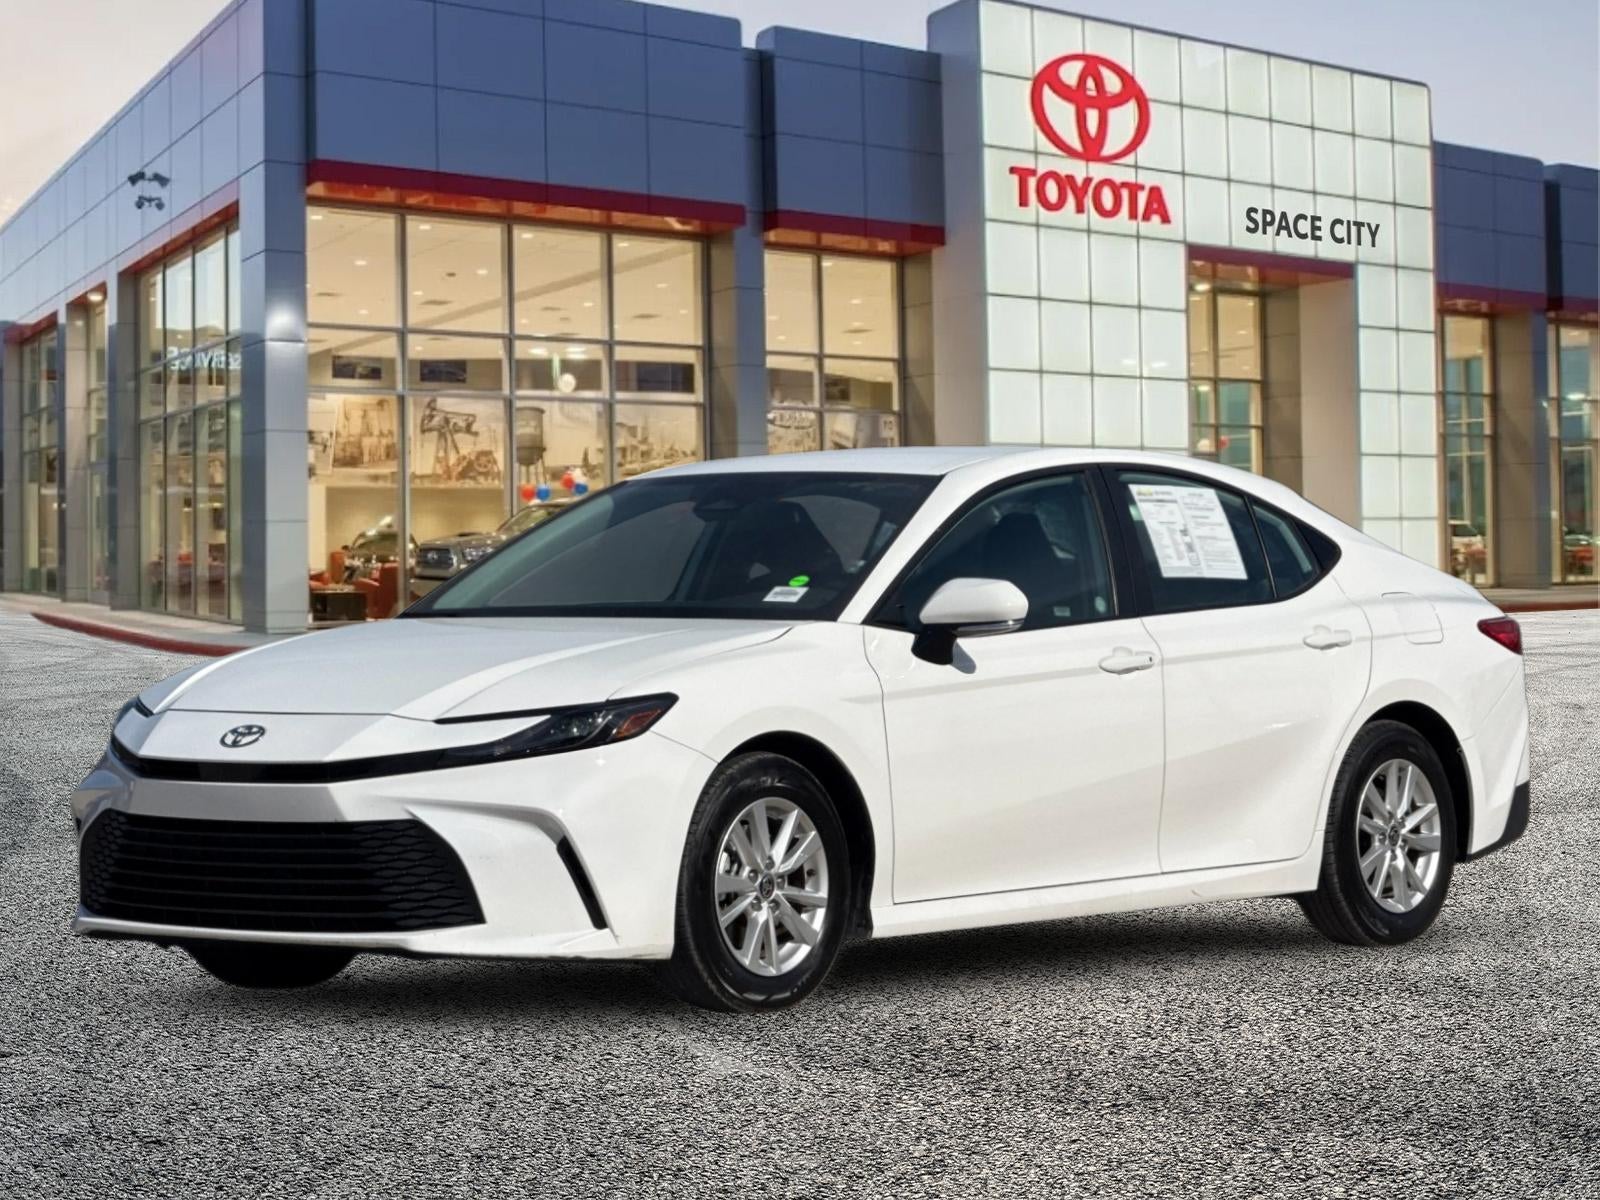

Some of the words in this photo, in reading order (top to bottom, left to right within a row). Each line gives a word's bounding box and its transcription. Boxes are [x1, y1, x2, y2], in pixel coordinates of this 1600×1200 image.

[1009, 166, 1171, 225] TOYOTA
[1245, 206, 1323, 242] SPACE
[1329, 217, 1381, 248] CITY
